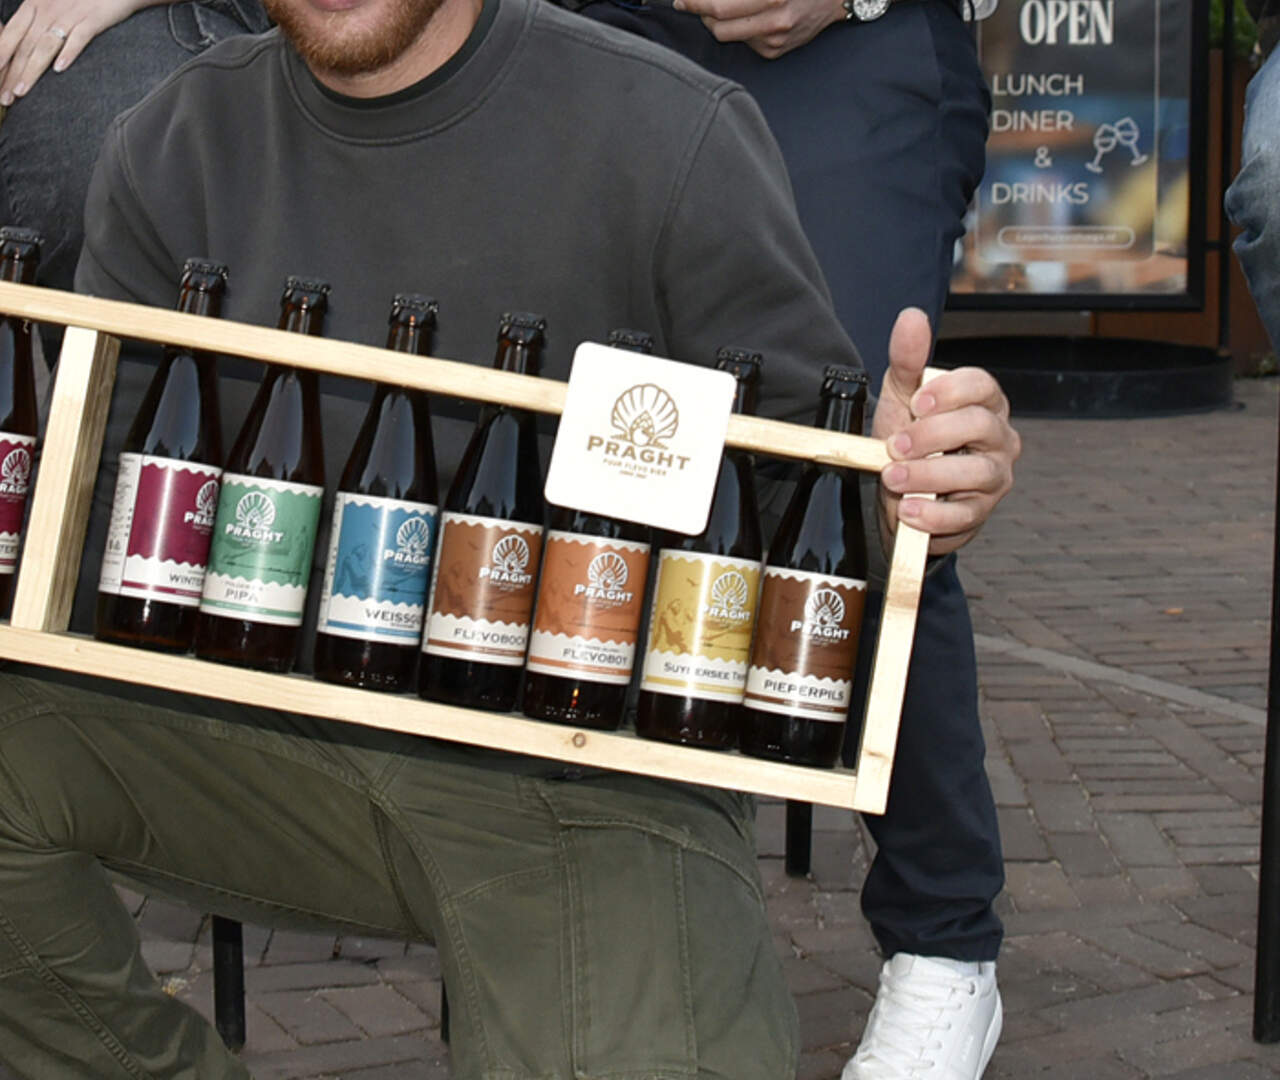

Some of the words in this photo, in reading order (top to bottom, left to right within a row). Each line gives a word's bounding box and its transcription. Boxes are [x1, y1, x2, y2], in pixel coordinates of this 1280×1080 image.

[992, 74, 1084, 95] LUNCH
[991, 110, 1074, 132] DINER
[1034, 146, 1053, 168] &
[991, 182, 1089, 205] DRINKS
[586, 434, 691, 471] PRAGHT
[183, 511, 215, 527] PRAG
[225, 523, 284, 543] PRAGHT
[478, 564, 533, 585] PRAGHT
[225, 587, 259, 604] PIPA
[574, 582, 634, 603] PRAGHT
[702, 605, 751, 622] PRAGHT
[790, 619, 850, 640] PRAGHT
[763, 678, 845, 703] PIEPERPILS
